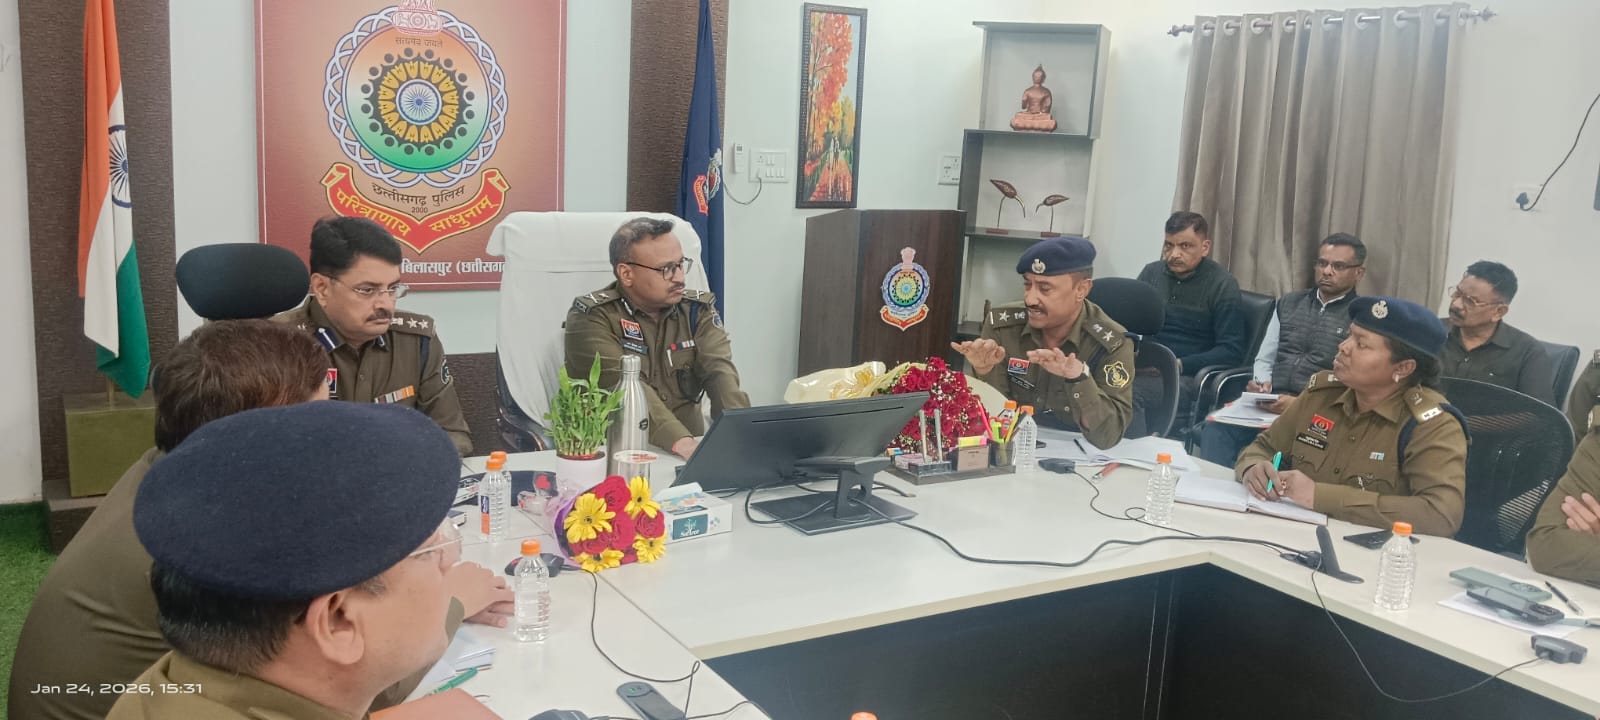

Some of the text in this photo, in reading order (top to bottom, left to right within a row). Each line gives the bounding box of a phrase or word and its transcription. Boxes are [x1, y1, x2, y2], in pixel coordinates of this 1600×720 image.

[432, 185, 465, 207] पुलिस
[336, 188, 499, 236] परित्राणाय साधुनाम्
[411, 206, 428, 214] 2000
[401, 258, 452, 275] बिलासपुर
